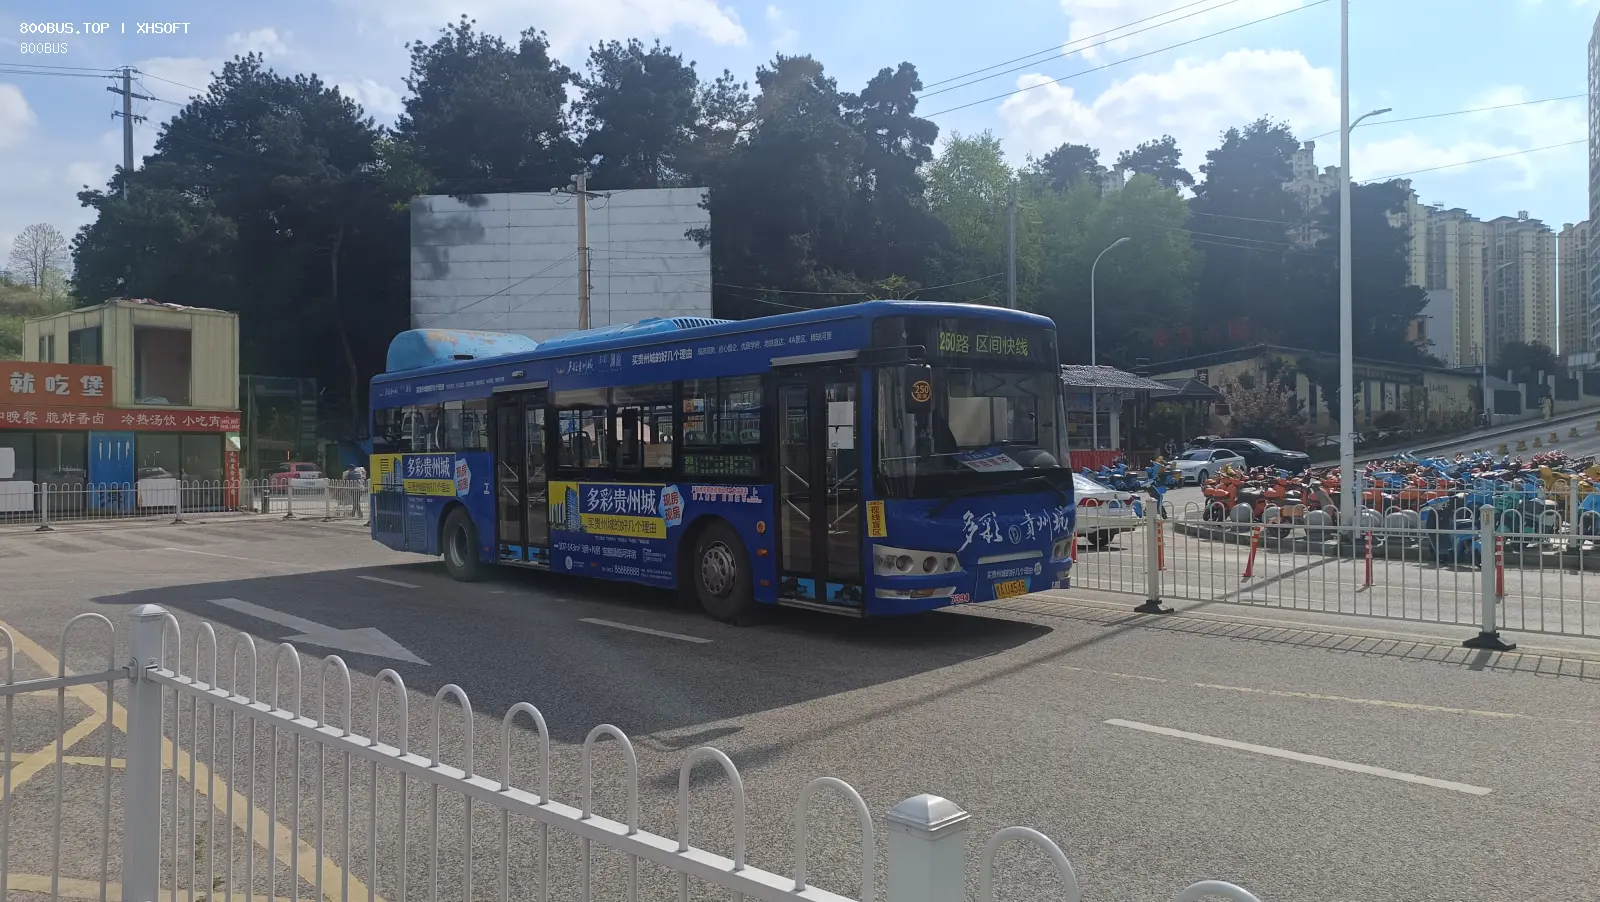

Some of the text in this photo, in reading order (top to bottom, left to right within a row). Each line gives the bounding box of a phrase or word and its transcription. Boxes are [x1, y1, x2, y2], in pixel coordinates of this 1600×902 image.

[939, 331, 1028, 356] 250路 区间快线
[631, 348, 693, 366] 买贵州城的好几个理由
[10, 371, 105, 397] 就吃堡
[914, 385, 929, 394] 250
[45, 411, 105, 425] 脆炸香卤
[121, 413, 177, 426] 冷热汤饮
[407, 456, 451, 478] 多彩贵州城
[586, 487, 657, 515] 多彩贵州城
[663, 491, 679, 507] 现房
[665, 506, 681, 521] 现房
[870, 505, 882, 537] 视线盲区
[587, 517, 657, 534] 买贵州城的好几个理由
[957, 509, 1004, 553] 多彩
